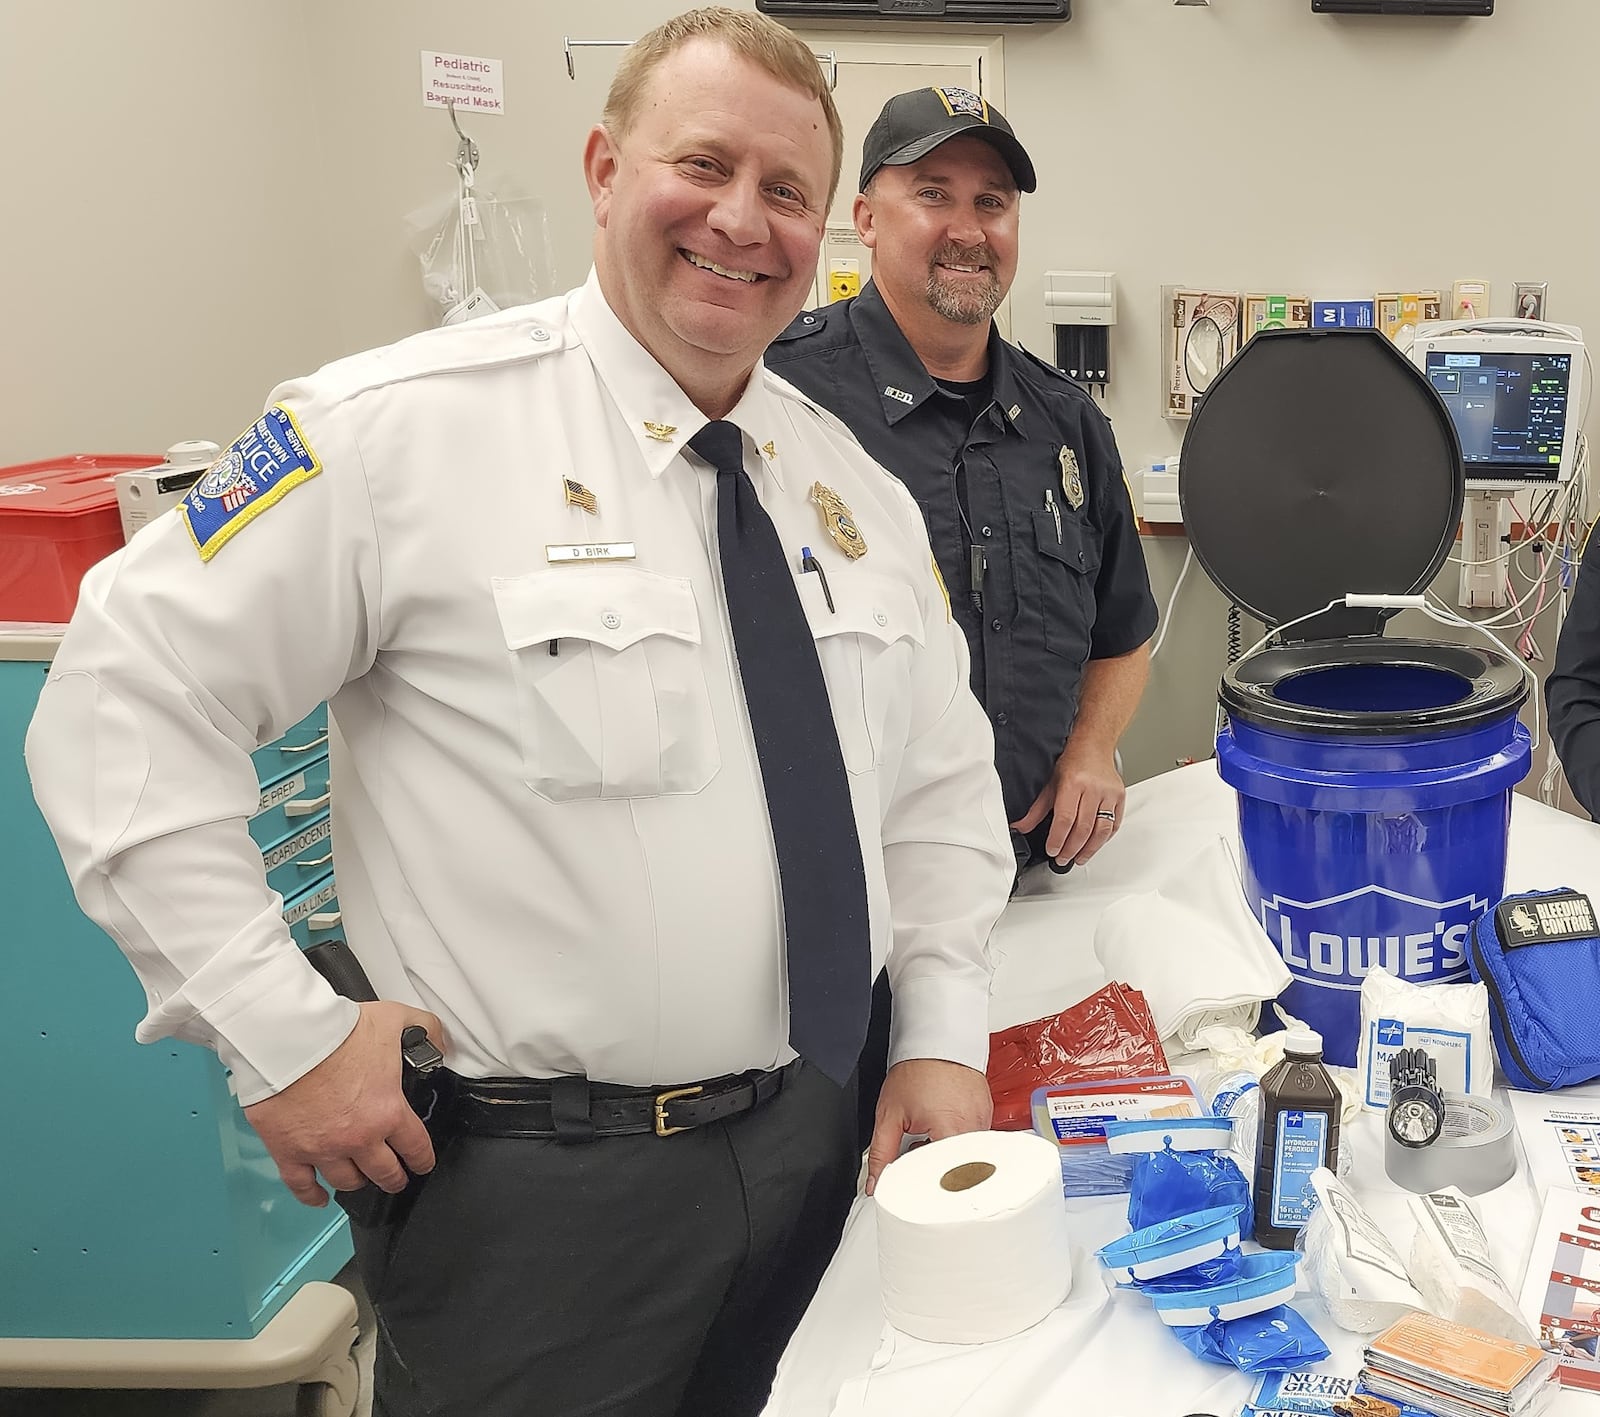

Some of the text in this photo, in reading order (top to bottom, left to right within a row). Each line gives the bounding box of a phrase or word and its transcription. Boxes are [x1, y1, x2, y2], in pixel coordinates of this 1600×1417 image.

[434, 56, 491, 73] Pediatric
[433, 79, 494, 94] Resuscitation
[426, 91, 449, 104] Bag
[473, 96, 501, 109] Mask
[1271, 303, 1285, 313] L
[1403, 302, 1417, 312] S
[1323, 308, 1336, 323] M
[1173, 364, 1181, 391] Restore
[284, 427, 308, 459] SERVE
[572, 547, 610, 557] D BIRK
[271, 780, 296, 804] PREP
[283, 903, 308, 924] UMA
[310, 890, 330, 911] LINE
[1535, 899, 1590, 920] BLEEDING
[1540, 915, 1593, 935] CONTROL
[1279, 914, 1469, 977] LOWE'S
[1141, 1082, 1183, 1091] LEADER
[1090, 1100, 1115, 1108] Aid
[1119, 1098, 1140, 1106] Kit
[1284, 1139, 1319, 1147] HYDROGEN
[1284, 1145, 1315, 1153] PEROXIDE
[1279, 1205, 1287, 1213] 16
[1570, 1236, 1579, 1244] 1
[1562, 1275, 1572, 1284] 2
[1550, 1318, 1560, 1326] 3
[1288, 1372, 1353, 1386] NUTRI
[1284, 1382, 1352, 1396] GRAIN
